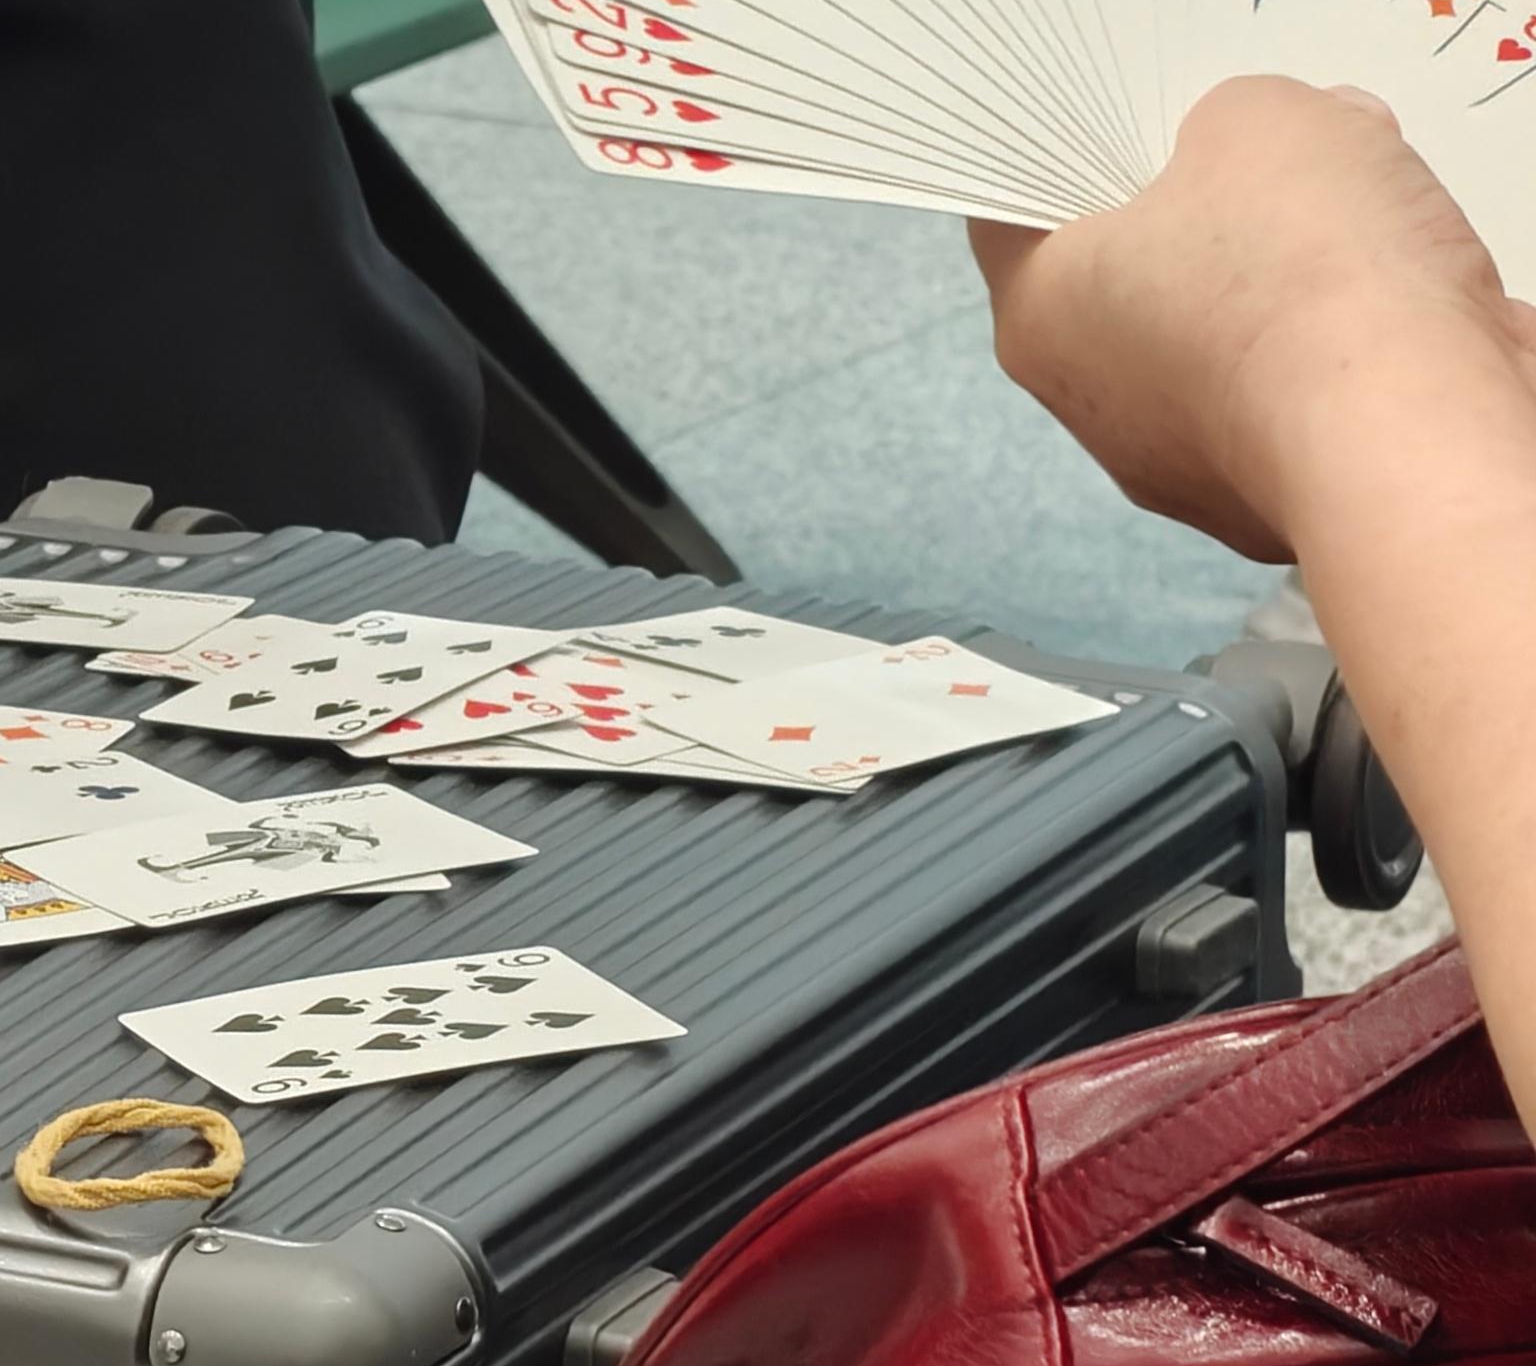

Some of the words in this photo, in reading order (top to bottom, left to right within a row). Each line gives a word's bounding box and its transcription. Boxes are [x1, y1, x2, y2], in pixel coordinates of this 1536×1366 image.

[579, 82, 658, 115] 5
[598, 138, 673, 169] 8
[62, 719, 112, 731] 8
[67, 757, 119, 770] 2
